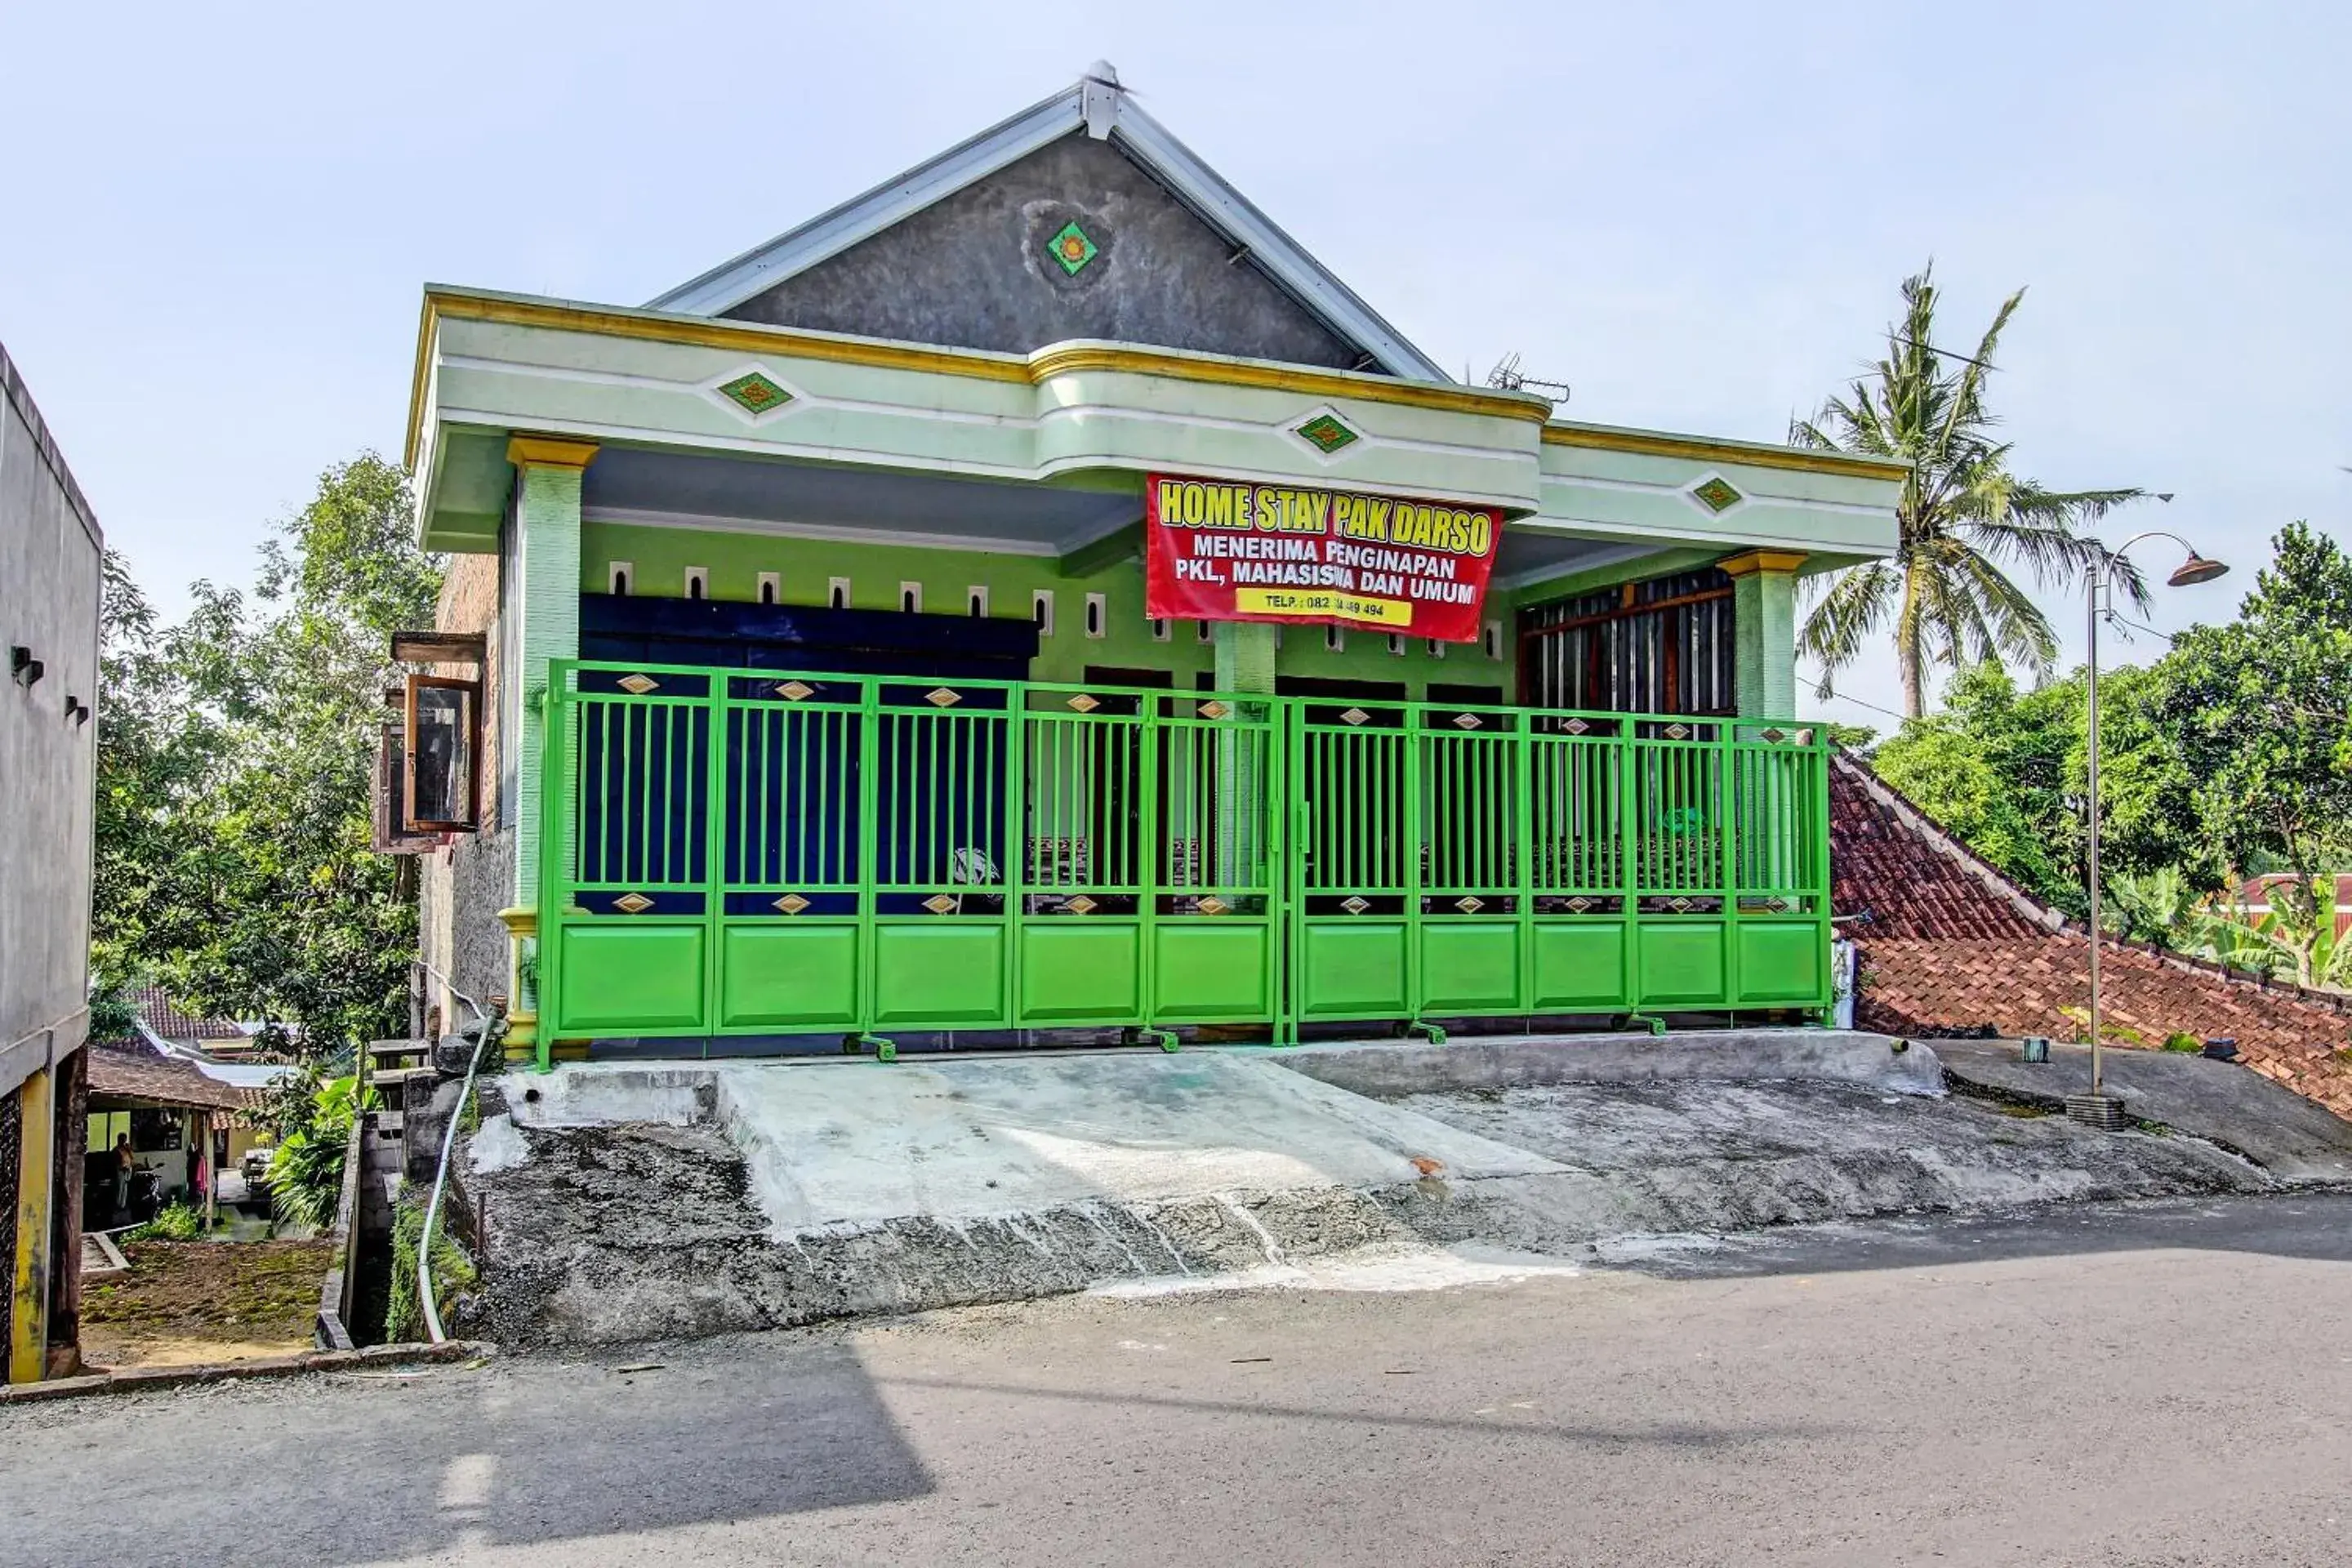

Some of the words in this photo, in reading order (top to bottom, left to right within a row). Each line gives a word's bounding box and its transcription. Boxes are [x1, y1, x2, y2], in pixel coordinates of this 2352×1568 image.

[1159, 480, 1252, 530] HOME
[1254, 486, 1330, 534] STAY
[1334, 493, 1392, 542] PAK
[1390, 501, 1492, 557] DARSO
[1194, 534, 1318, 562] MENERIMA
[1325, 541, 1456, 579] PENGINAPAN
[1175, 559, 1226, 586] PKL,
[1232, 561, 1355, 590] MAHASISWA
[1360, 572, 1405, 596] DAN
[1410, 578, 1477, 604] UMUM
